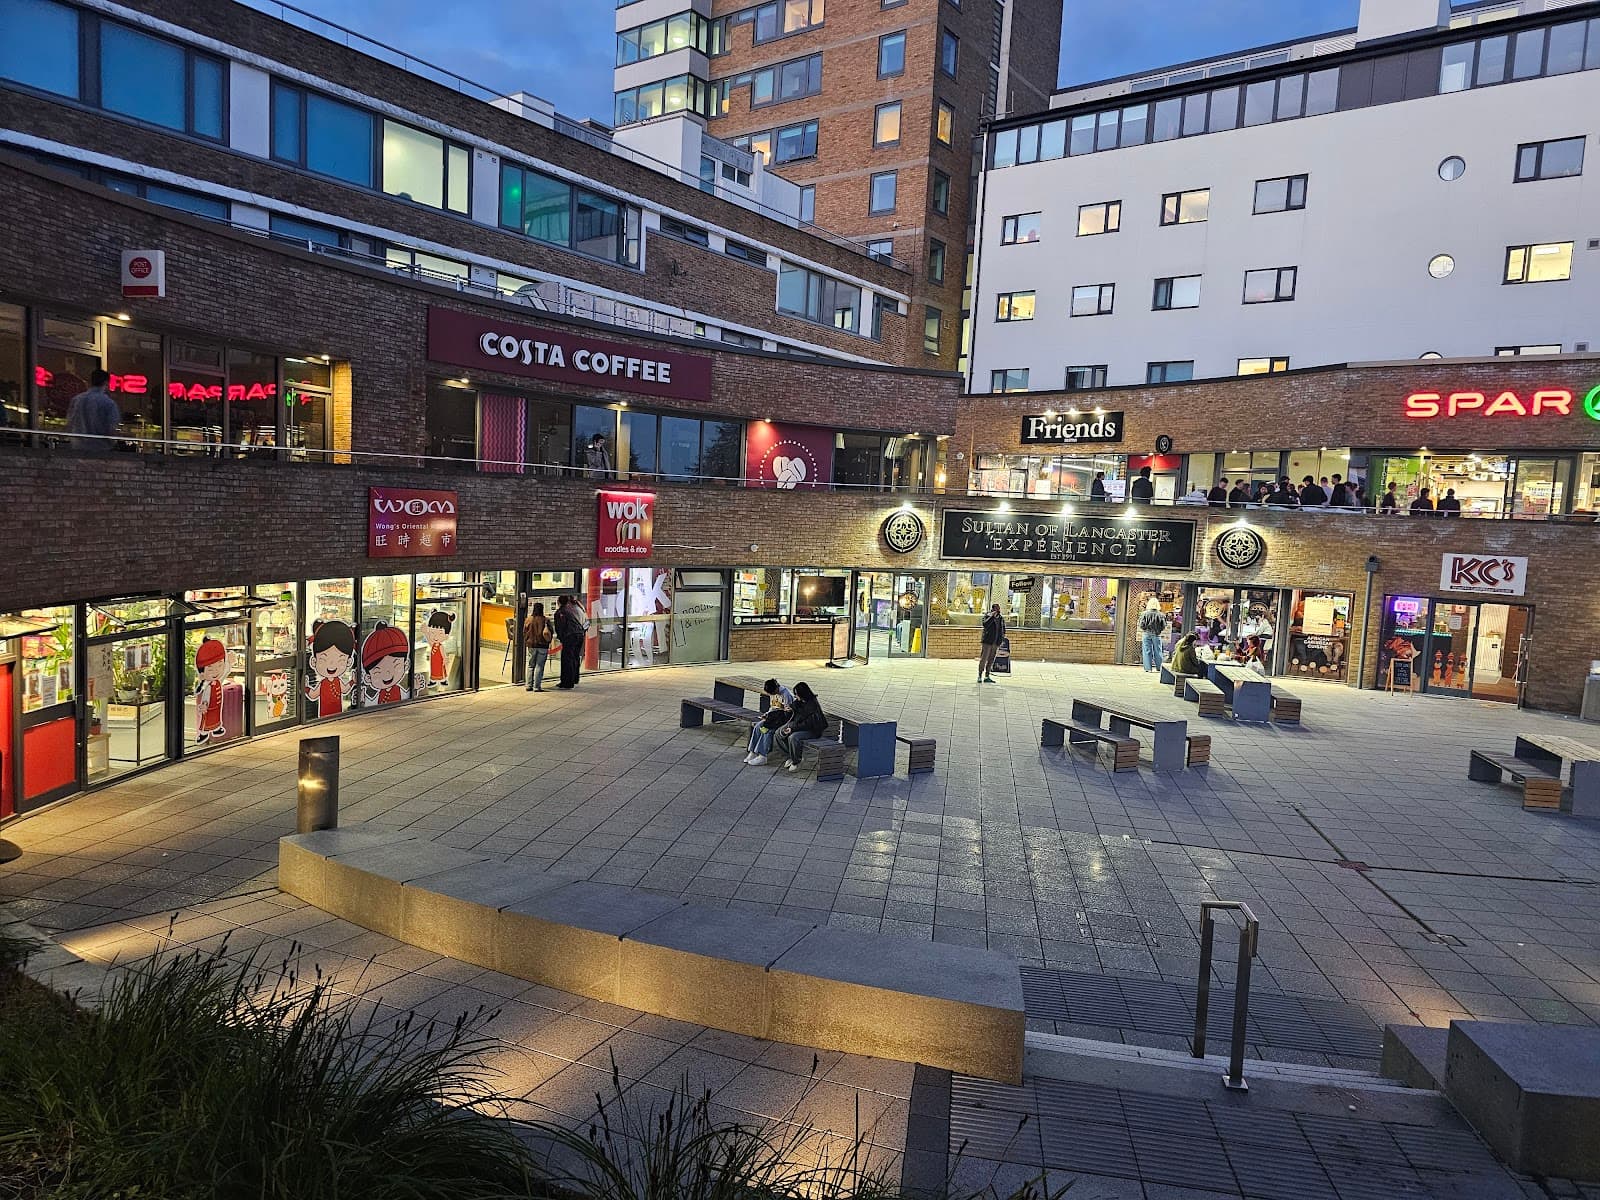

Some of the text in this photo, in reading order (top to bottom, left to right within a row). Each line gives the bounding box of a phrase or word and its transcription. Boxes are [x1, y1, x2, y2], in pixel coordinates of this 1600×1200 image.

[479, 332, 671, 384] COSTA COFFEE
[1405, 390, 1572, 418] SPAR
[1027, 415, 1116, 439] Friends
[606, 497, 648, 520] wok
[375, 523, 400, 531] Wong's
[961, 517, 1172, 542] SULTAN OF LANCASTER
[604, 545, 647, 554] noodles & rice
[992, 538, 1137, 557] EXPERIENCE
[1451, 557, 1515, 586] KC's
